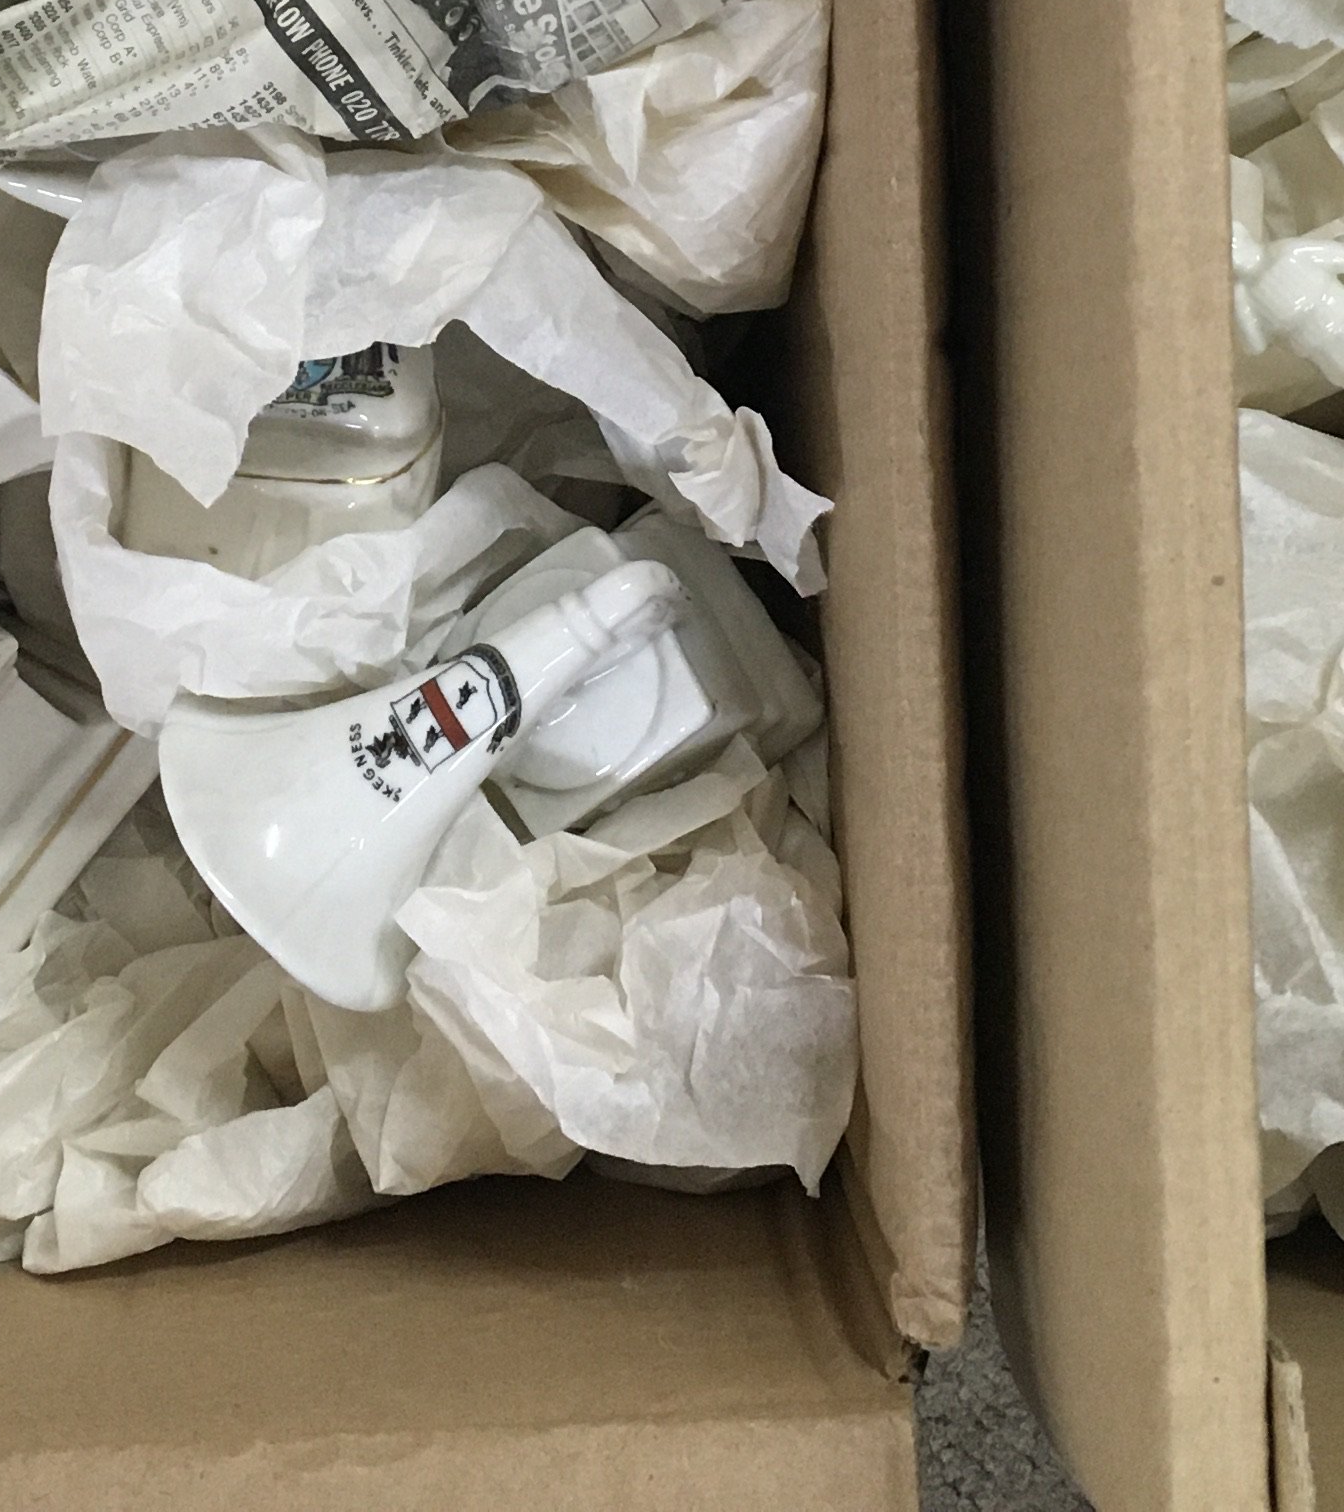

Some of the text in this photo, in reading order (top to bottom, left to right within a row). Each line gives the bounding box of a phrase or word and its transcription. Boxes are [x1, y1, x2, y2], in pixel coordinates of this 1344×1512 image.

[302, 38, 378, 120] PHONE 020
[348, 722, 403, 803] SKEGNESS
